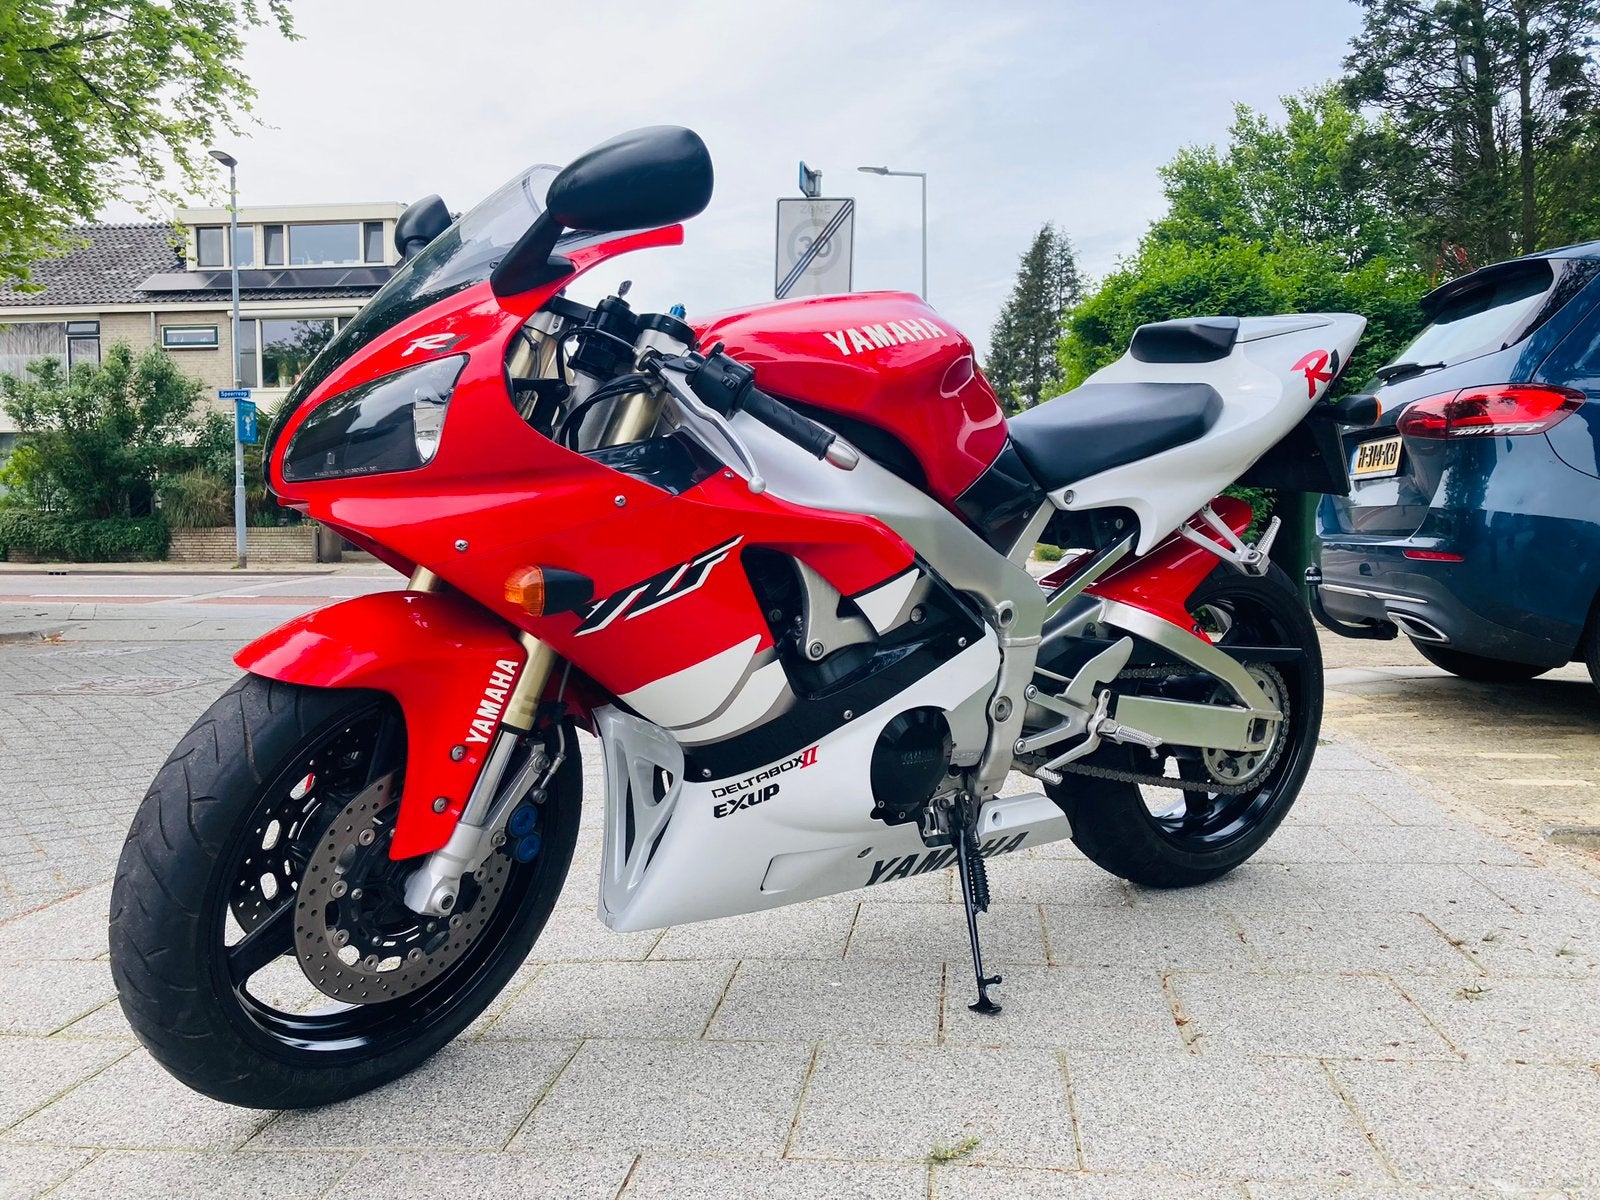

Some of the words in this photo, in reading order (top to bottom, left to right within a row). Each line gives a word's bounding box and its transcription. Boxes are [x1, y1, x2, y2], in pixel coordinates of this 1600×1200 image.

[823, 318, 948, 356] YAMAHA
[1290, 348, 1340, 400] R1
[465, 659, 519, 743] YAMAHA
[713, 783, 780, 818] EXUP
